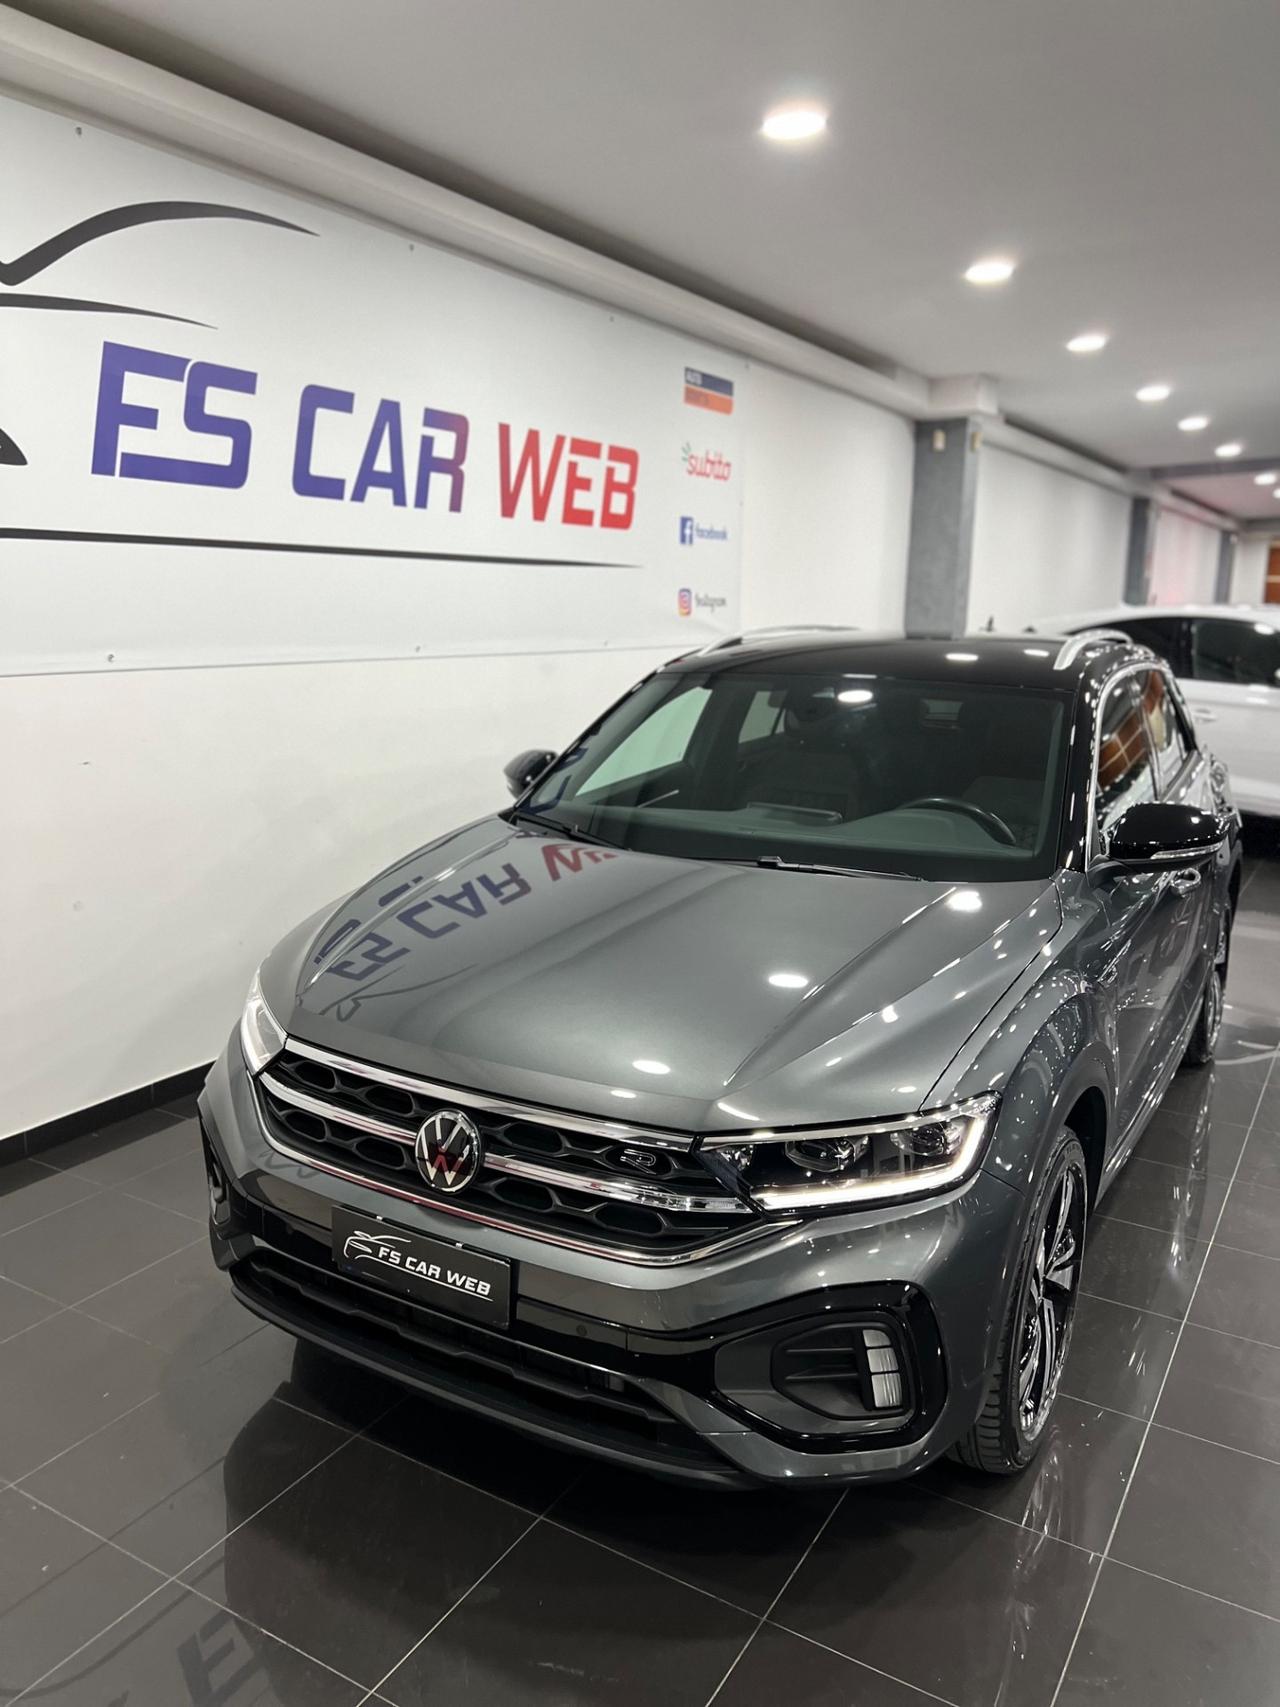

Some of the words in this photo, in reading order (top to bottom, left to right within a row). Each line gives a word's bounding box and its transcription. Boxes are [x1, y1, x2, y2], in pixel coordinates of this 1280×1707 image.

[92, 341, 258, 489] FS
[292, 384, 469, 513] CAR
[498, 422, 639, 530] WEB
[686, 450, 732, 481] subito
[378, 1246, 401, 1265] FS
[405, 1256, 441, 1279] CAR
[446, 1270, 491, 1296] WEB
